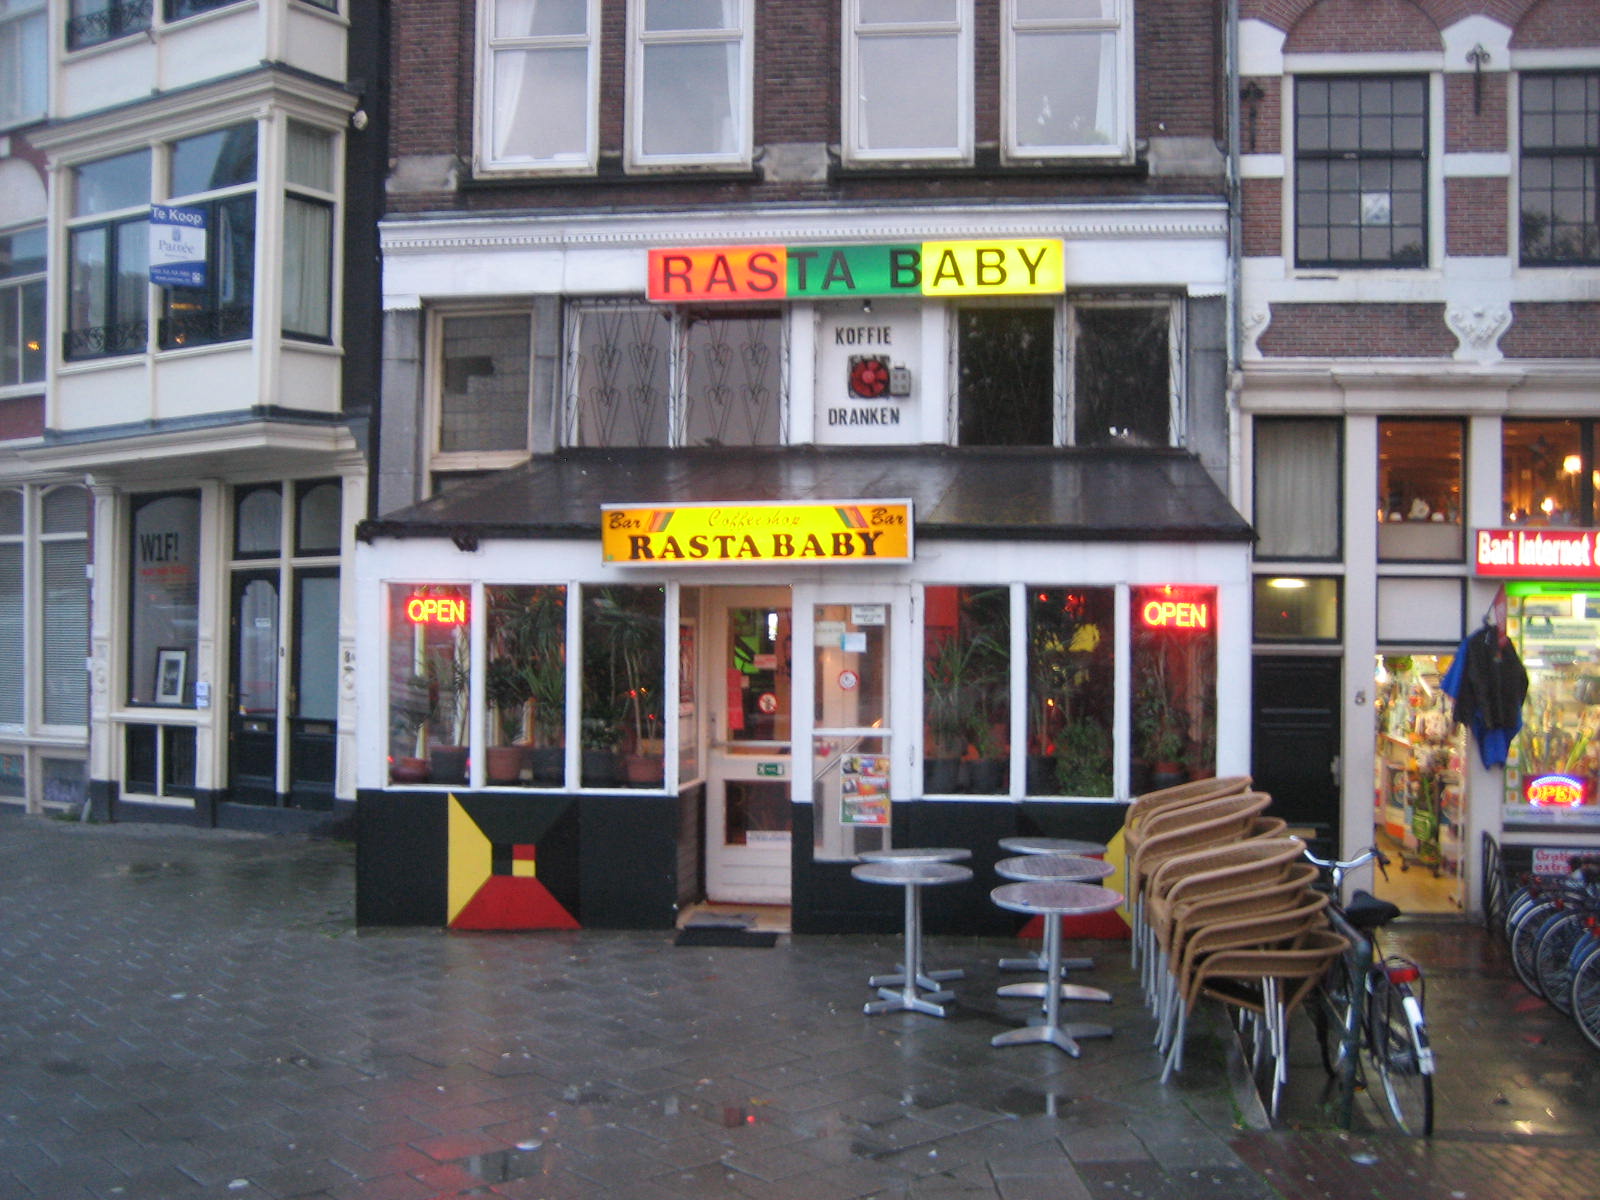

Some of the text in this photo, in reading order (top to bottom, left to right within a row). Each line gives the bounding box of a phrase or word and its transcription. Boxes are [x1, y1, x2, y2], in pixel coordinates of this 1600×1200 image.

[151, 207, 204, 226] Te Koop
[661, 246, 1049, 295] RASTA BABY
[834, 326, 893, 346] KOFFIE
[828, 406, 900, 427] DRANKEN
[608, 511, 642, 530] Bar
[870, 506, 905, 526] Bar
[628, 530, 884, 560] RASTA BABY
[1478, 531, 1515, 565] Bari
[1518, 531, 1590, 567] Internet
[407, 598, 466, 623] OPEN
[1143, 601, 1207, 628] OPEN
[1527, 784, 1582, 804] OPEN
